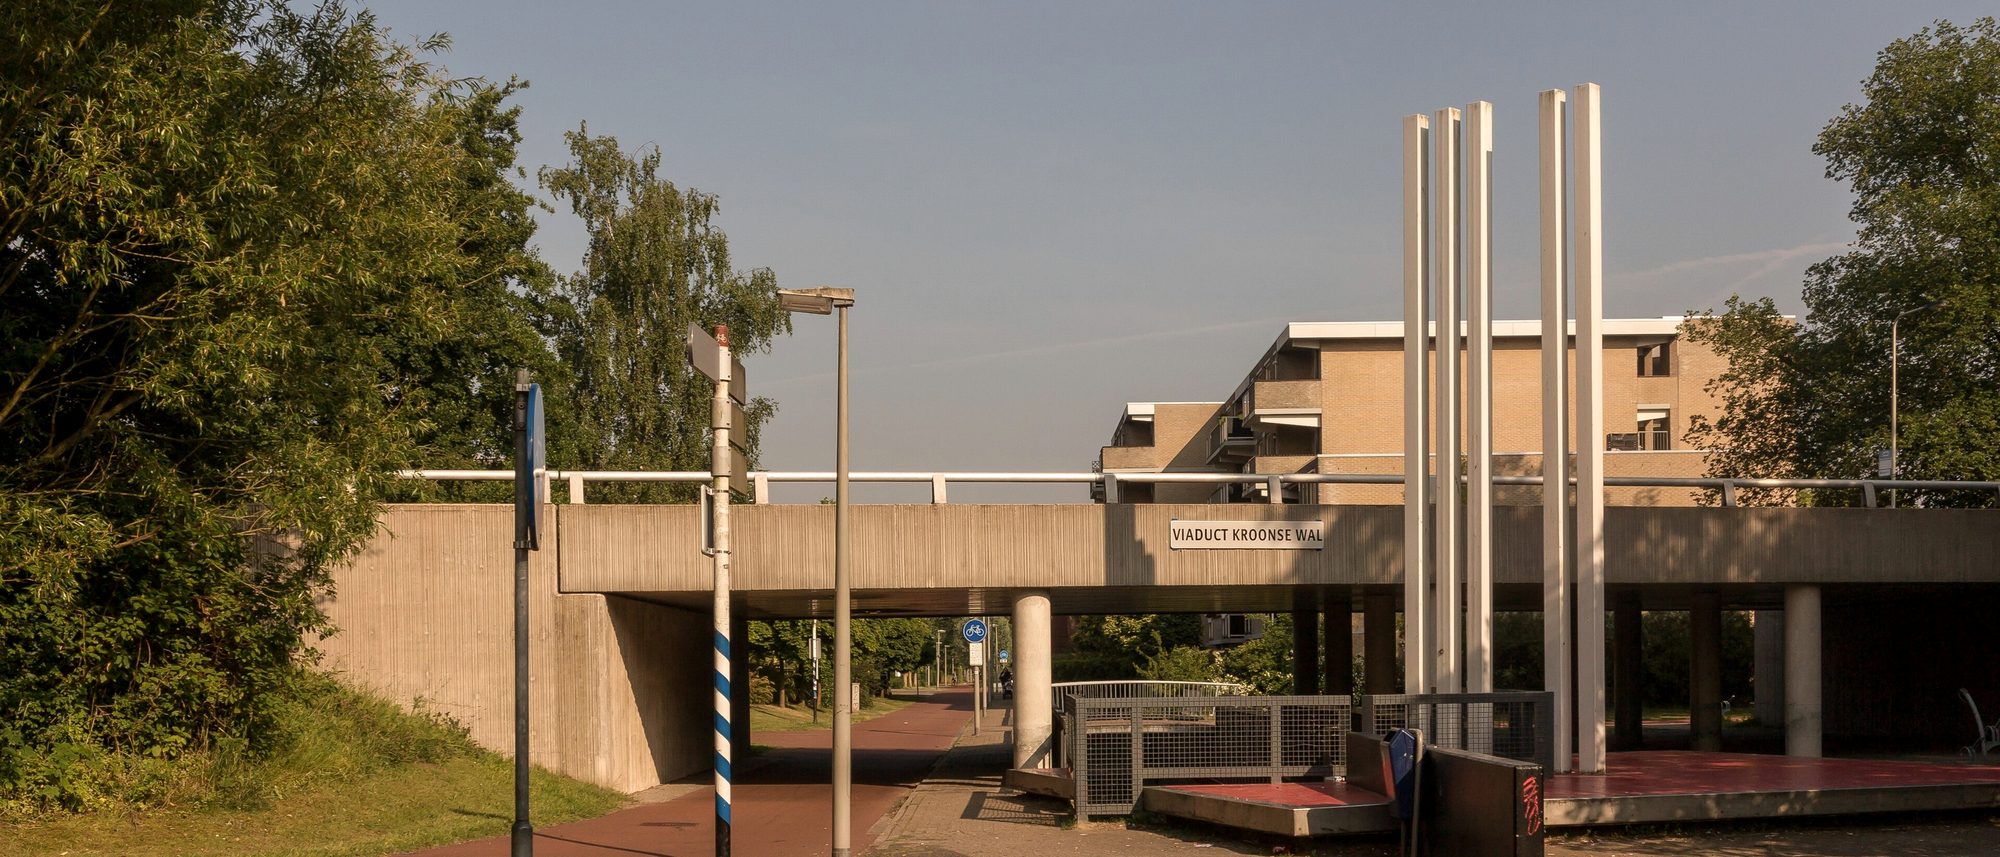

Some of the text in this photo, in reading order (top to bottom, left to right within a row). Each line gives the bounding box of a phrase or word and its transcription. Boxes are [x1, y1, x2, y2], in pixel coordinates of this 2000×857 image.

[1172, 528, 1323, 542] VIADUCT KROONSE WAL
